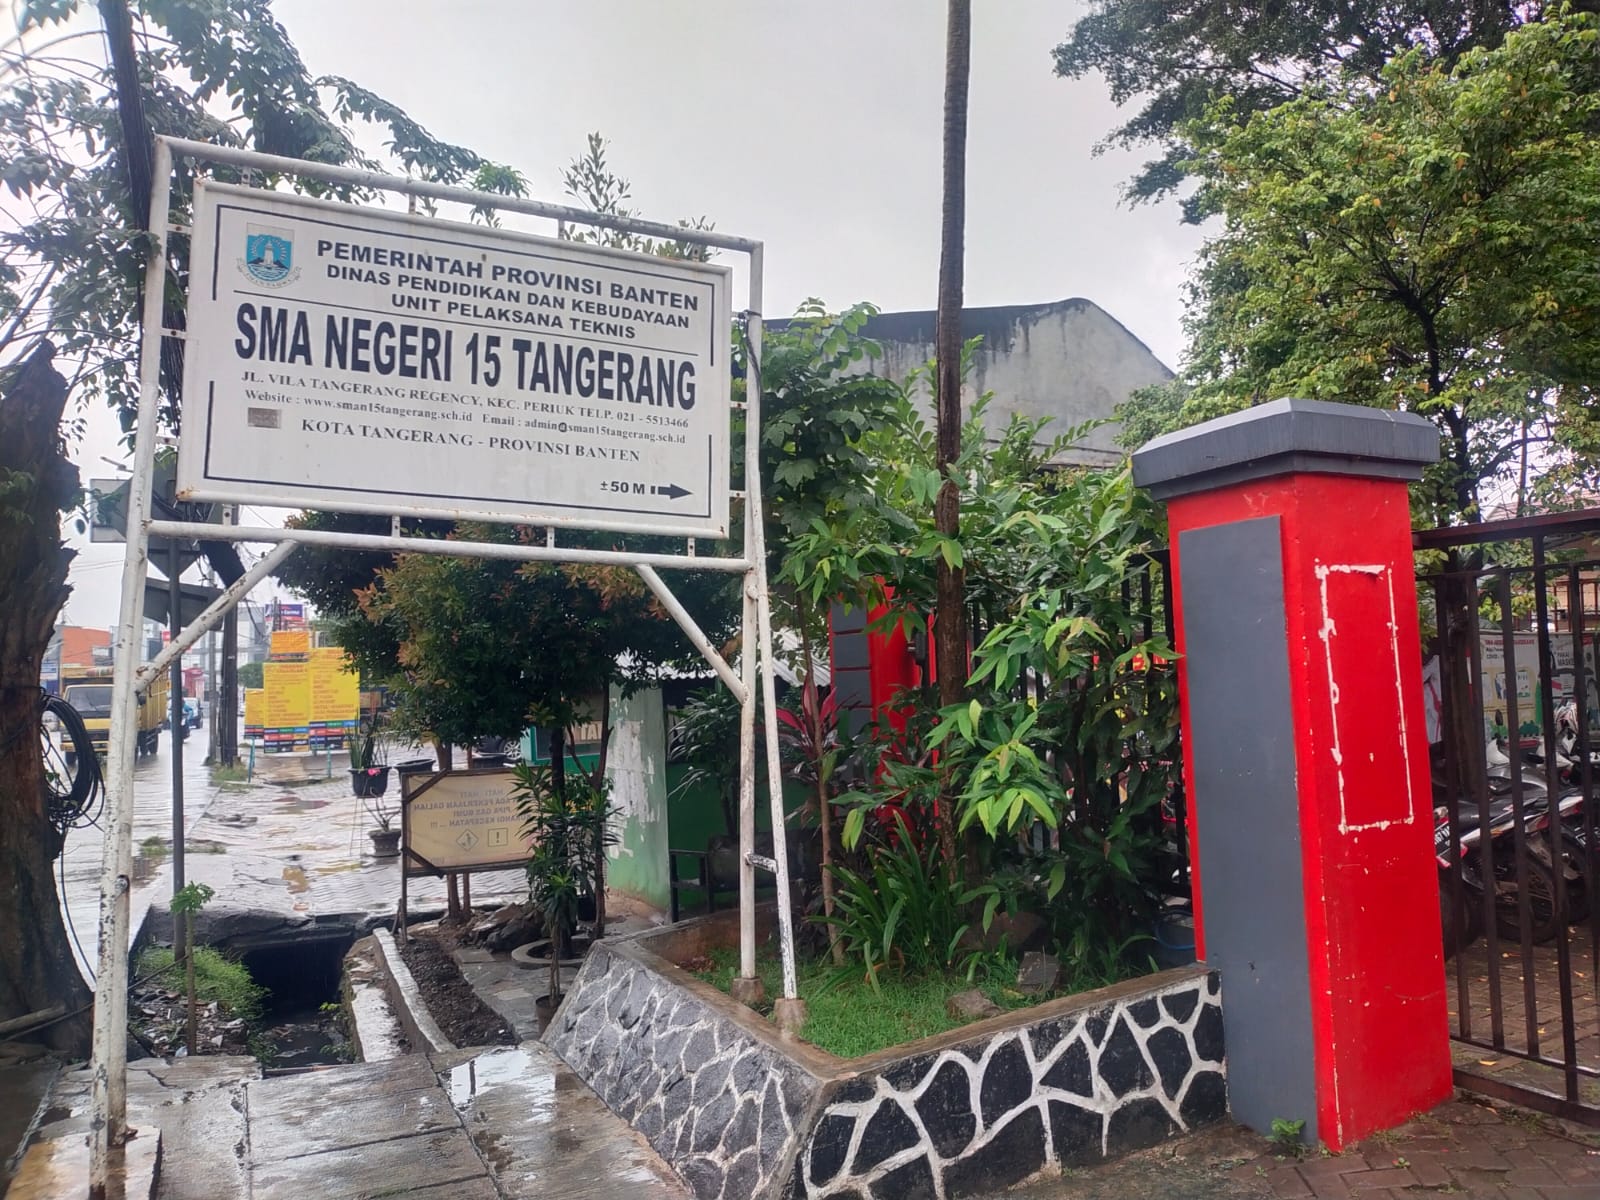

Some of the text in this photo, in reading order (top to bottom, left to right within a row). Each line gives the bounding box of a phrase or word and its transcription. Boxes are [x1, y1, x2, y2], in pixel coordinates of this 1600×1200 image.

[317, 240, 698, 311] PEMERINTAH PROVINSI BANTEN
[327, 264, 391, 286] DINAS
[398, 274, 520, 303] PENDIDIKAN
[527, 292, 565, 310] DAN
[572, 299, 689, 329] KEBUDAYAAN
[392, 294, 636, 339] UNIT PELAKSANA TEKNIS
[235, 303, 696, 411] SMA NEGERI 15 TANGERANG
[241, 371, 264, 383] JL.
[269, 374, 306, 388] VILA
[310, 378, 406, 399] TANGERANG
[487, 397, 520, 410] KEC.
[524, 401, 575, 416] PERIUK
[578, 406, 613, 420] TELP.
[616, 410, 636, 422] 021
[646, 414, 689, 429] 5513466
[245, 389, 292, 405] Website
[304, 397, 473, 422] www.sman15tangerang.sch.id
[482, 414, 515, 427] Email
[524, 419, 686, 444] admin@sman15tangerang.sch.id
[301, 418, 355, 436] KOTA
[359, 424, 473, 447] TANGERANG
[489, 436, 570, 456] PROVINSI
[575, 444, 640, 462] BANTEN
